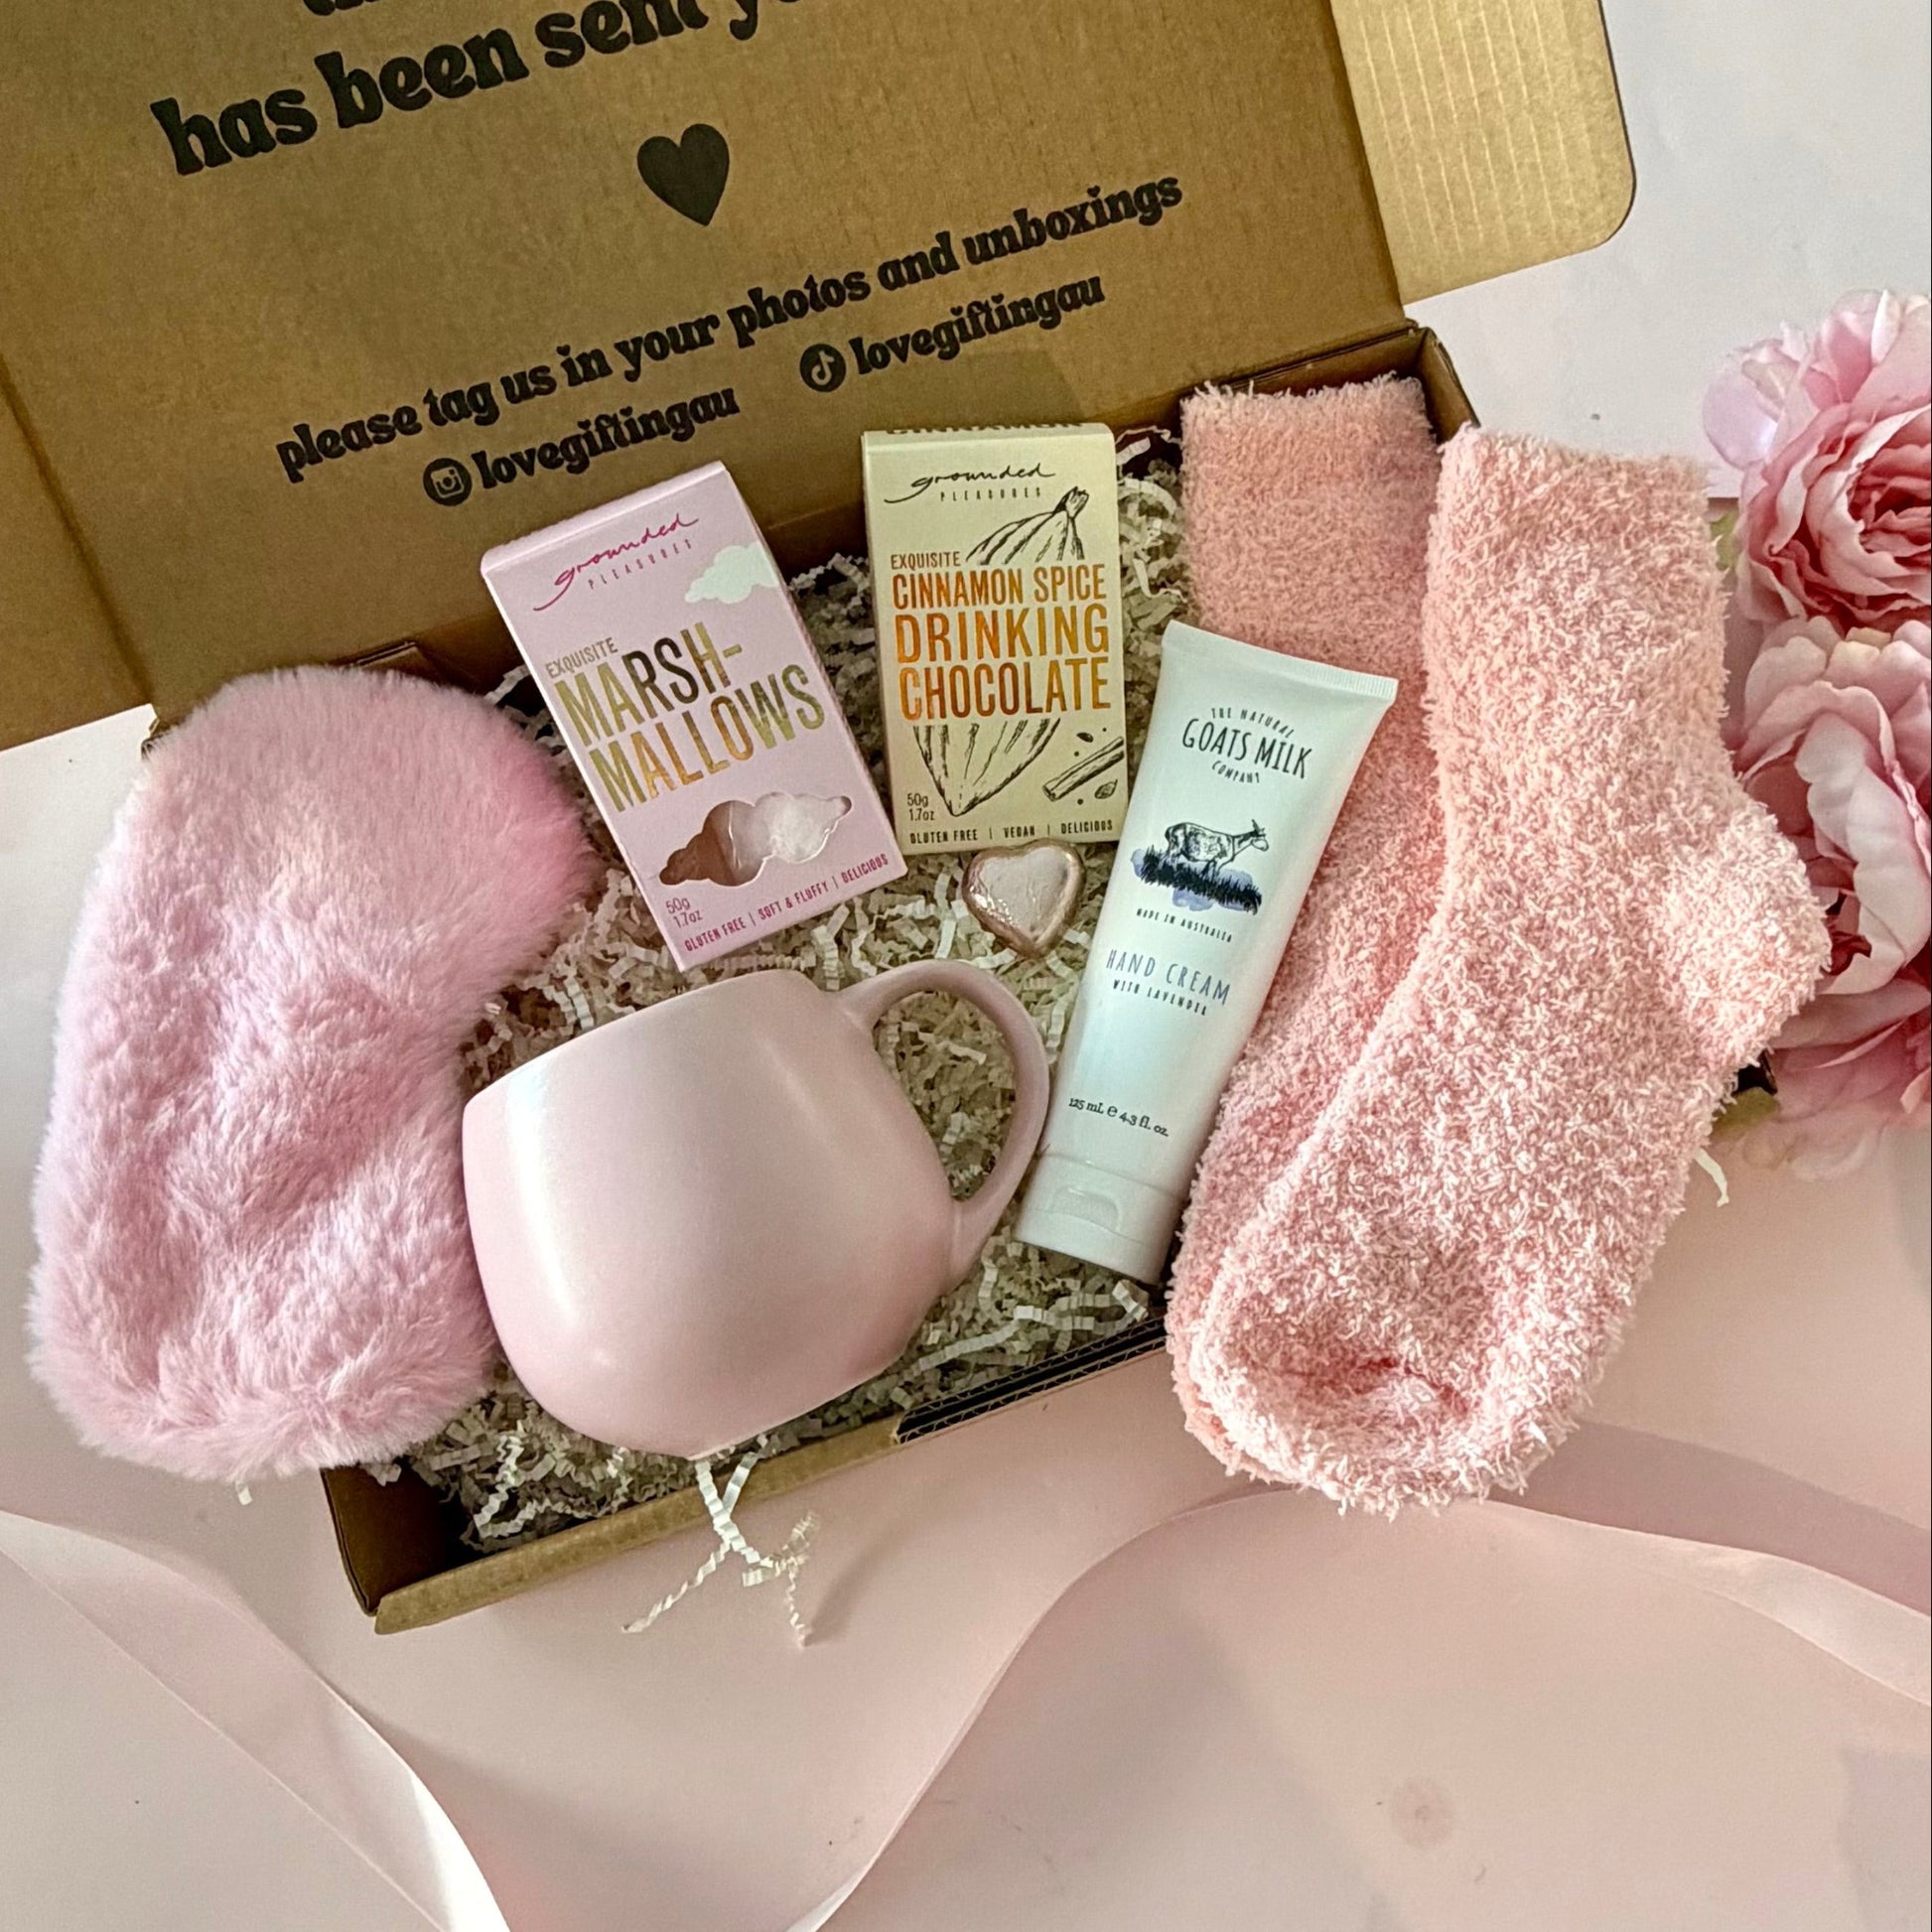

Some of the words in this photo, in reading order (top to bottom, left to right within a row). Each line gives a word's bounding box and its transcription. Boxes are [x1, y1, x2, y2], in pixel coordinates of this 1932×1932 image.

[151, 88, 318, 176] has
[315, 28, 529, 129] been
[276, 405, 422, 483] please
[423, 388, 500, 426] tag
[500, 364, 557, 403] us
[556, 345, 613, 386] in
[615, 314, 720, 382] your
[727, 271, 871, 348] photos
[877, 230, 960, 291] and
[962, 177, 1182, 263] unboxings
[849, 276, 1105, 374] lovegiftingau
[472, 387, 740, 489] lovegiftingau
[884, 463, 1056, 503] grounded
[940, 486, 1040, 502] PLEASURES
[533, 512, 699, 611] grounded
[588, 539, 691, 590] PLEASURES
[891, 551, 961, 570] EXQUISITE
[893, 568, 1024, 610] CINNAMON
[1034, 564, 1107, 603] SPICE
[895, 603, 1109, 664] DRINKING
[546, 636, 618, 679] EXQUISITE
[554, 621, 742, 747] MARSH-
[898, 656, 1111, 721] CHOCOLATE
[589, 664, 825, 812] MALLOWS
[1211, 707, 1231, 719] THE
[1241, 709, 1295, 739] NATURAL
[1182, 718, 1252, 760] GOATS
[1254, 737, 1312, 779] MILK
[1211, 759, 1260, 783] COMPANY
[907, 793, 929, 808] 50g
[908, 808, 935, 821] 1.7oz
[909, 831, 948, 844] GLUTEN
[953, 829, 978, 842] FREE
[1003, 825, 1035, 838] VEGAN
[1060, 820, 1113, 835] DELICIOUS
[665, 897, 691, 914] 50g
[673, 909, 703, 928] 1.7oz
[684, 929, 720, 952] GLUTEN
[722, 917, 747, 936] FREE
[758, 901, 782, 920] SOFT
[785, 897, 793, 909] &
[794, 881, 829, 904] FLUFFY
[841, 853, 889, 884] DELICIOUS
[1180, 918, 1232, 942] AUSTRALIA
[1106, 949, 1156, 977] HAND
[1166, 963, 1230, 1006] CREAM
[1113, 979, 1140, 994] WITH
[1147, 987, 1207, 1016] LAVENDER
[1068, 1097, 1085, 1110] 125
